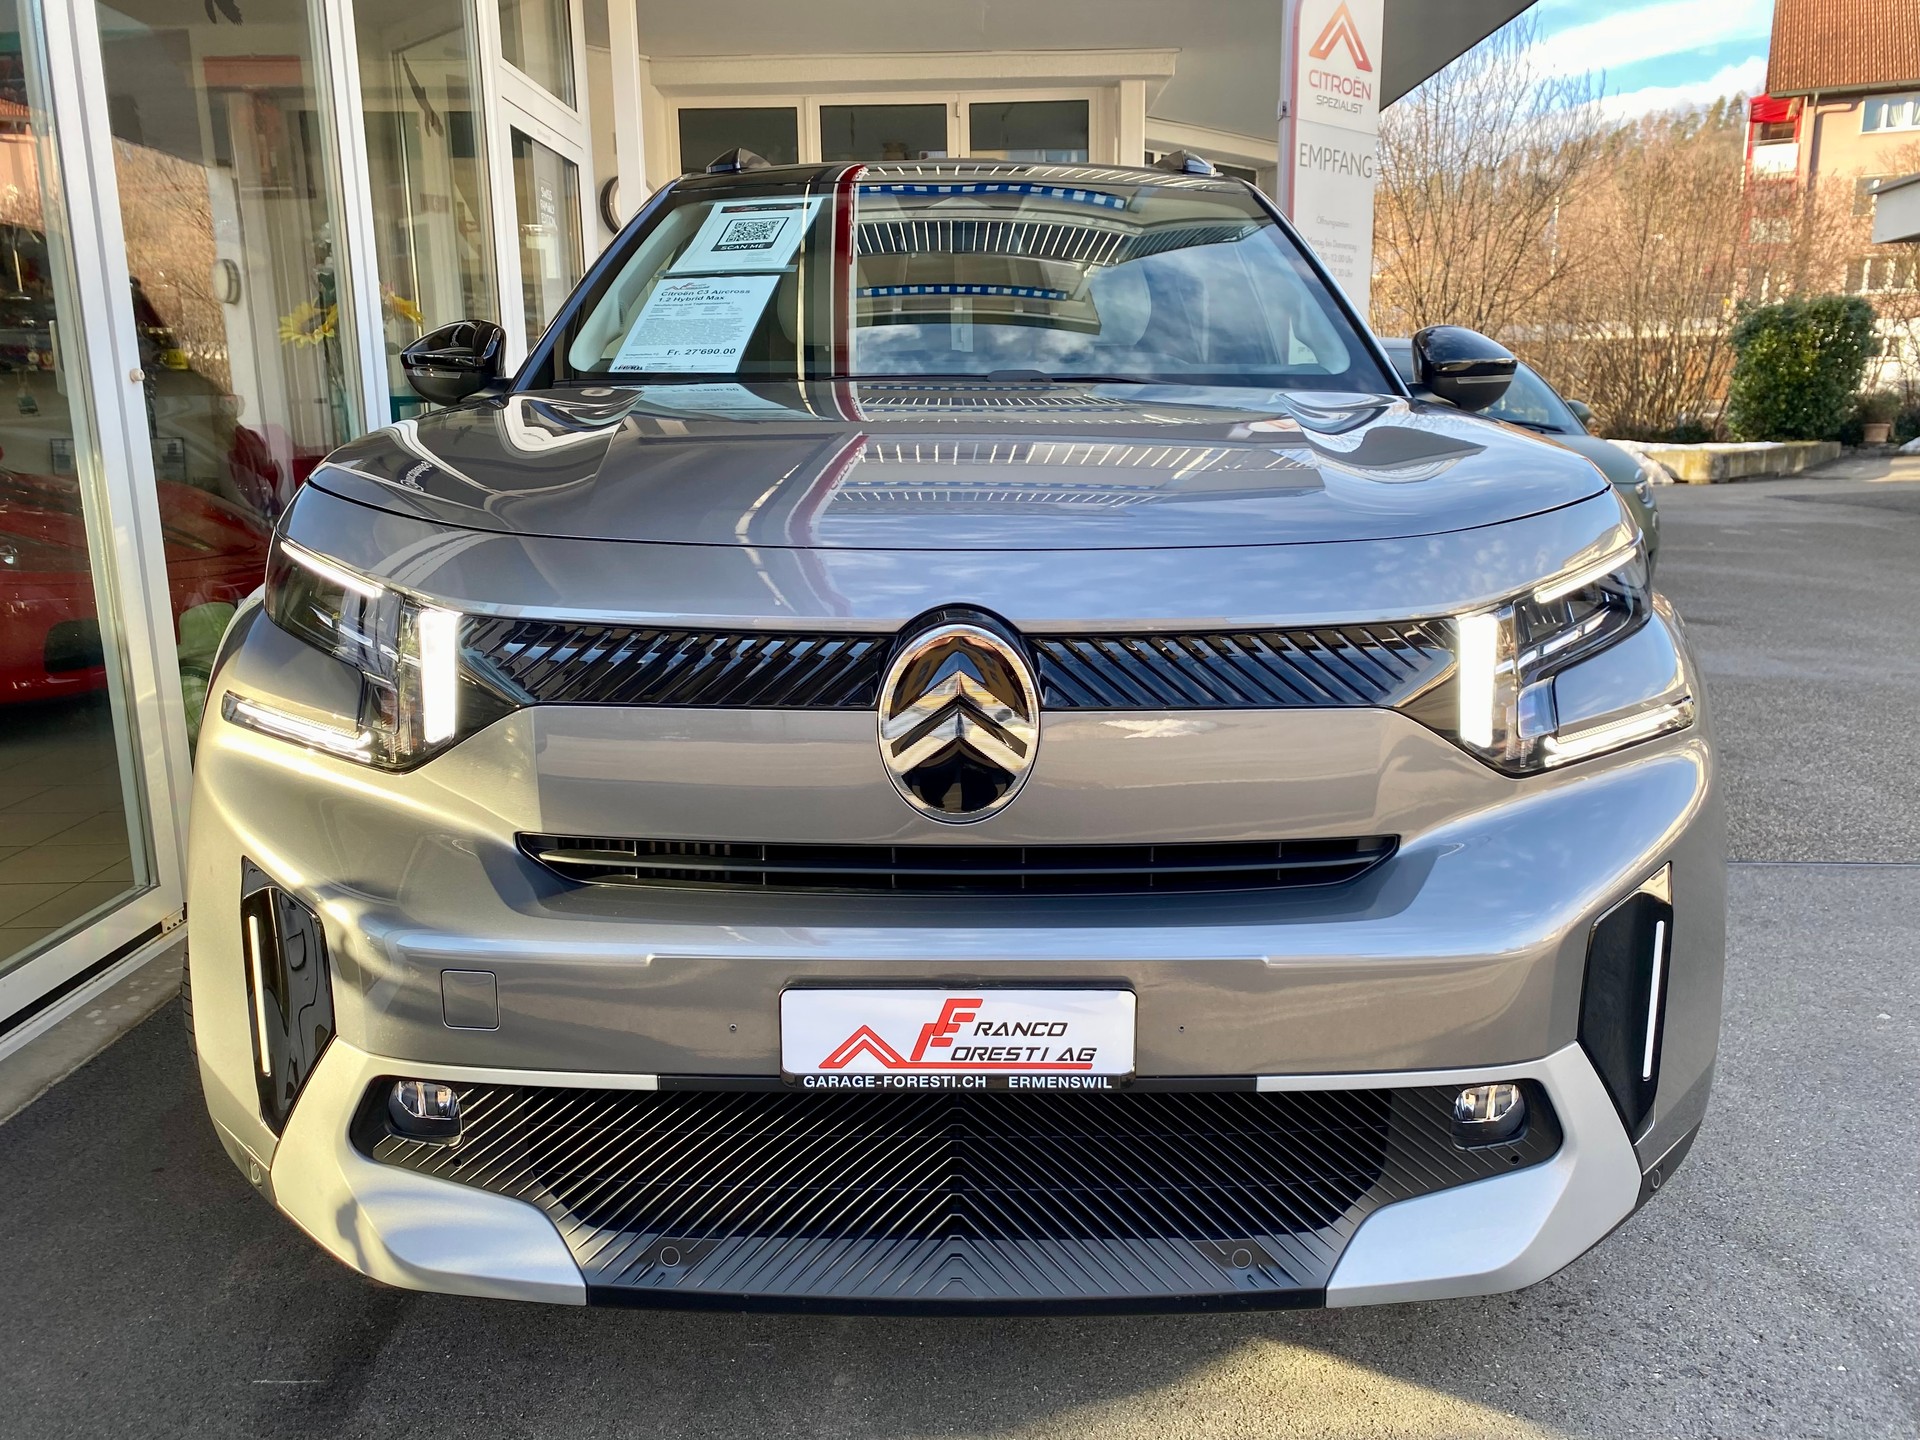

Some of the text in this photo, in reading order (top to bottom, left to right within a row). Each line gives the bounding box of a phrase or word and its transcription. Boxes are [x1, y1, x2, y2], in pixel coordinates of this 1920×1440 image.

[1308, 69, 1371, 101] CITROËN
[1316, 94, 1363, 115] SPEZIALIST
[1299, 143, 1372, 179] EMPFANG
[719, 243, 748, 251] SCAN
[661, 289, 694, 297] Citroën
[673, 295, 704, 303] Hybrid
[684, 347, 737, 356] 27'690.00
[1055, 1046, 1098, 1062] AG
[802, 1075, 1113, 1090] GARAGE-FORESTI.CH ERMENSWIL
